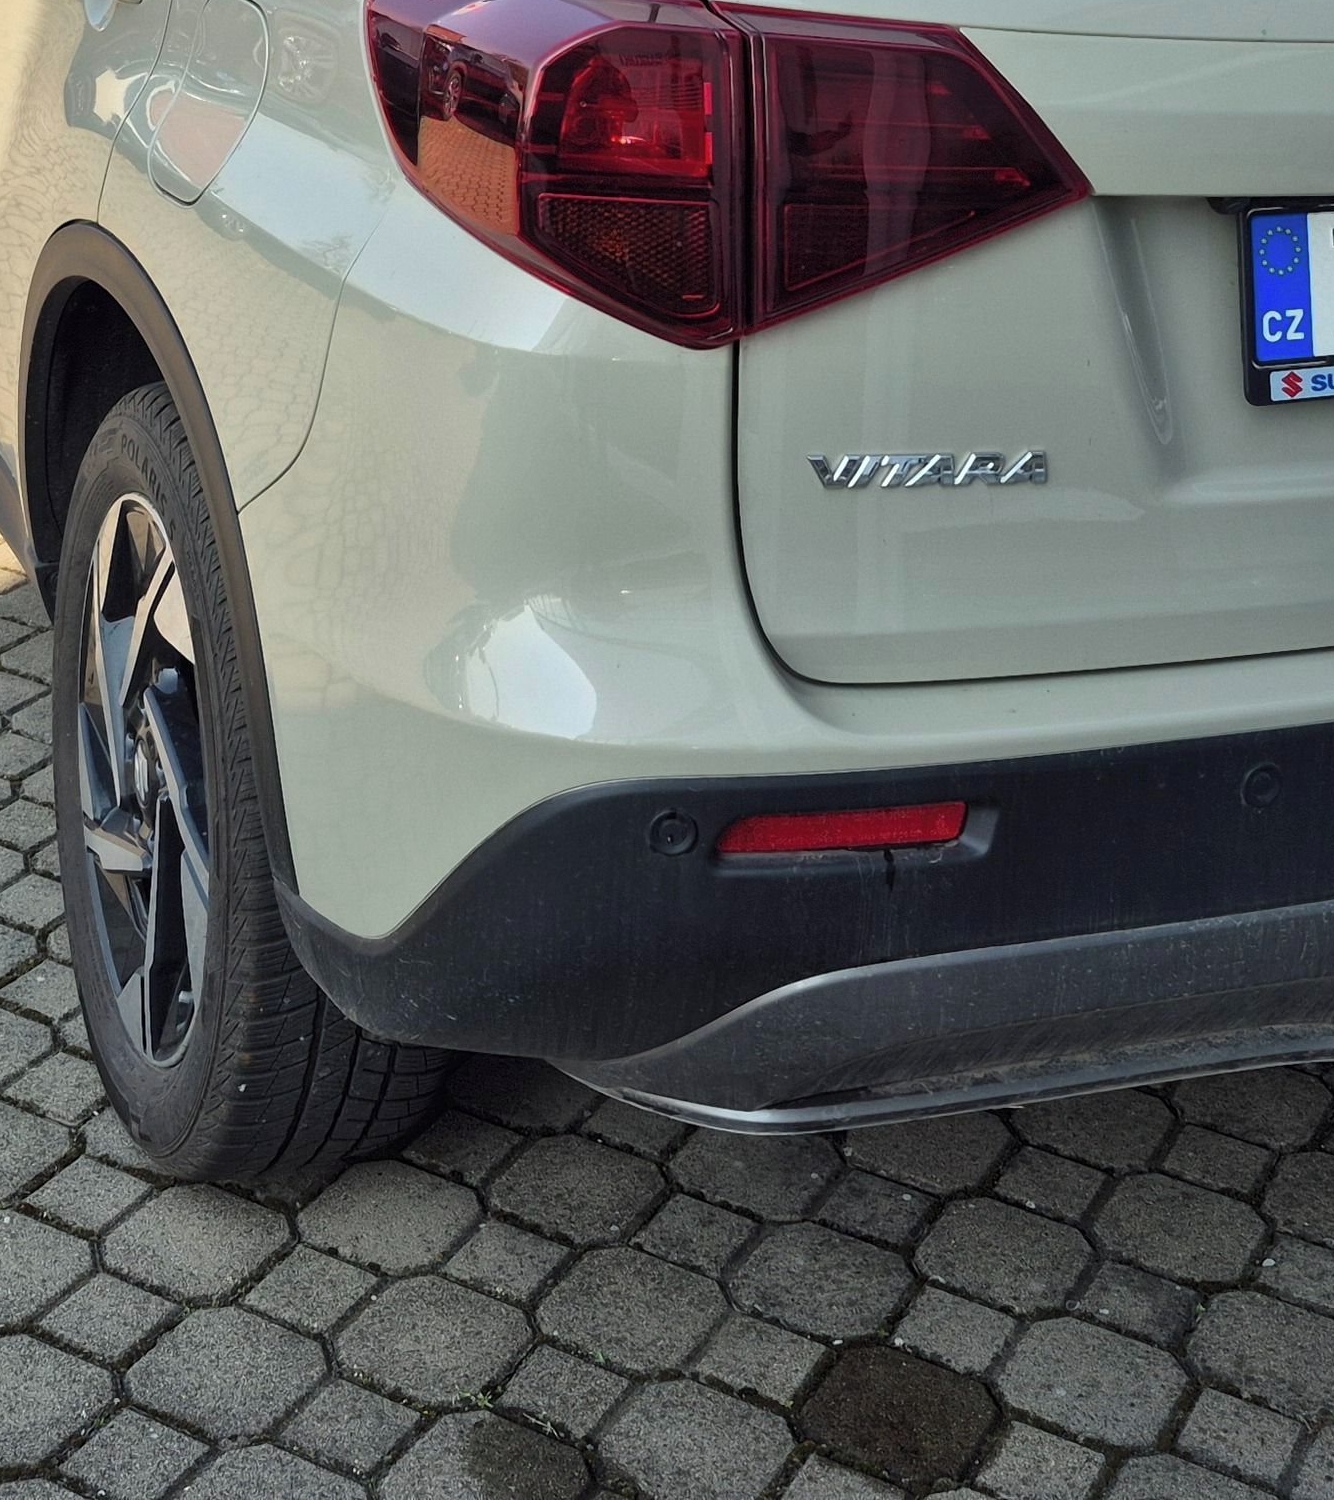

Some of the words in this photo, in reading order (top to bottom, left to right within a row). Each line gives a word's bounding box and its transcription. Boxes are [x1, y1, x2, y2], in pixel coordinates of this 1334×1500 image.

[1261, 308, 1306, 343] CZ
[121, 433, 167, 517] POLARIS
[806, 450, 1048, 489] VITARA
